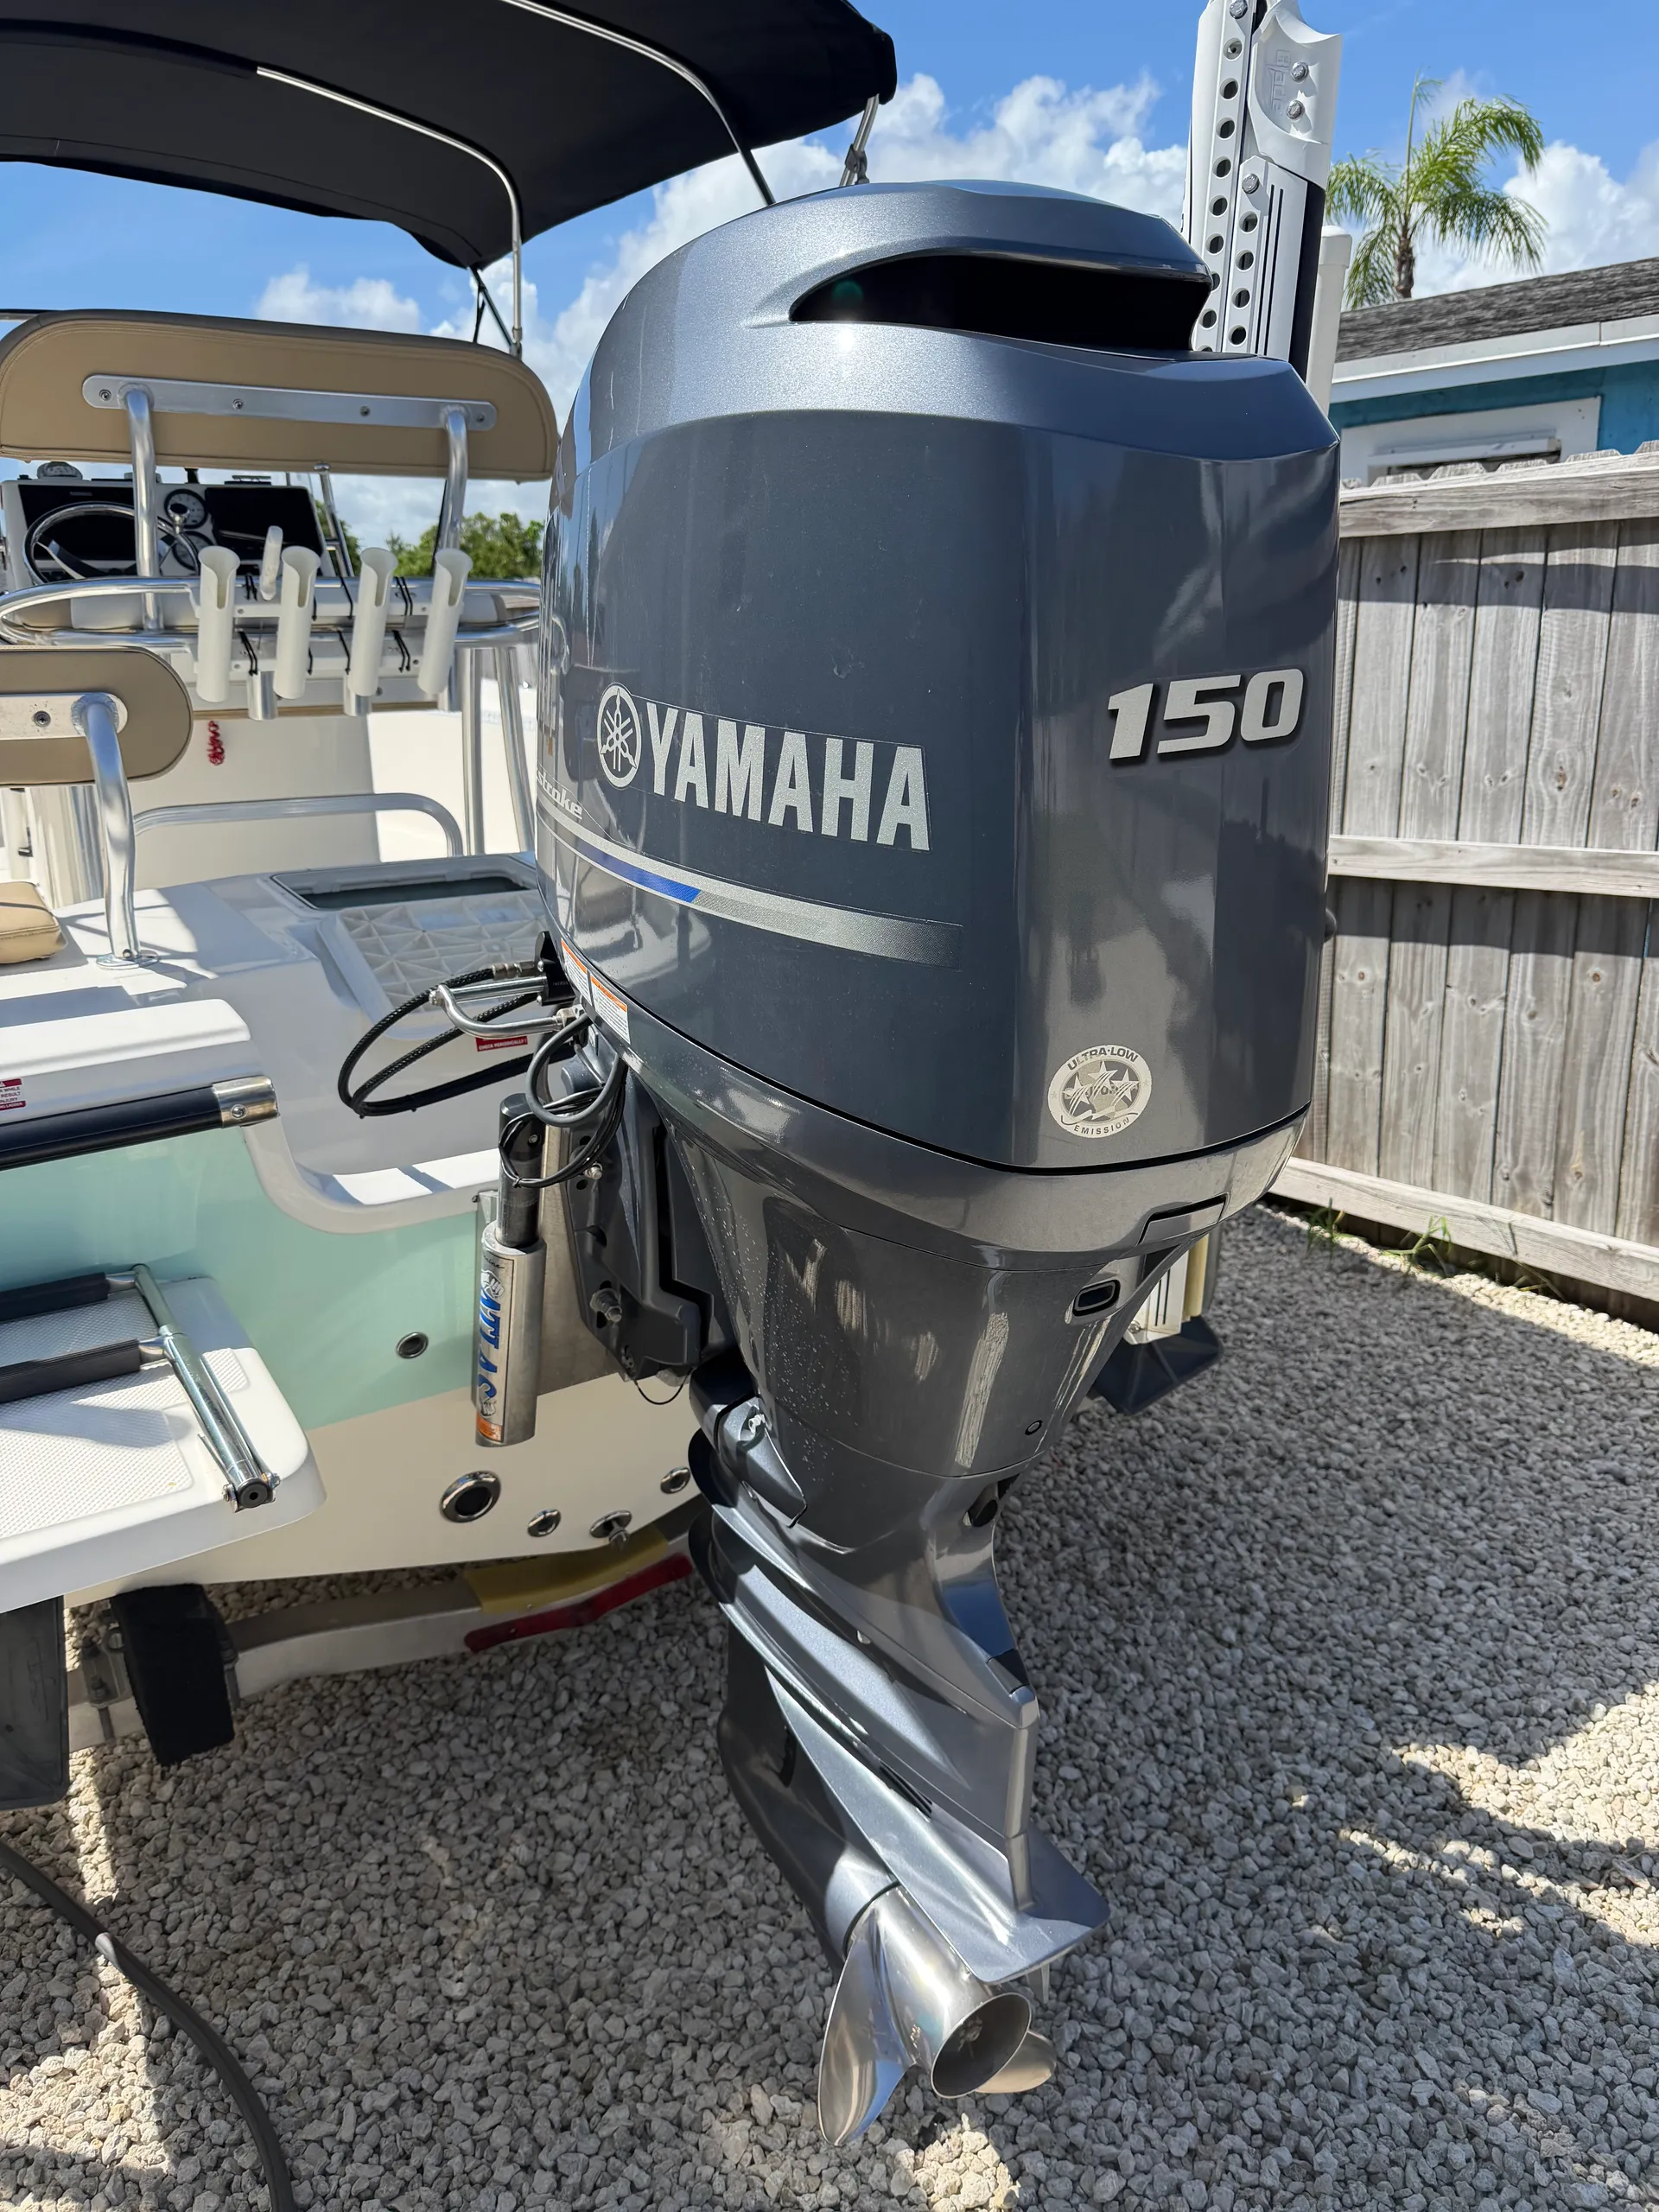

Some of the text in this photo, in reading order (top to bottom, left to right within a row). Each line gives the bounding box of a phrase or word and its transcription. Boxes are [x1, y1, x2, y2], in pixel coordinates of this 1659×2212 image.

[1108, 668, 1304, 760] 150
[645, 702, 930, 851] YAMAHA
[1073, 1116, 1130, 1135] EMISSION
